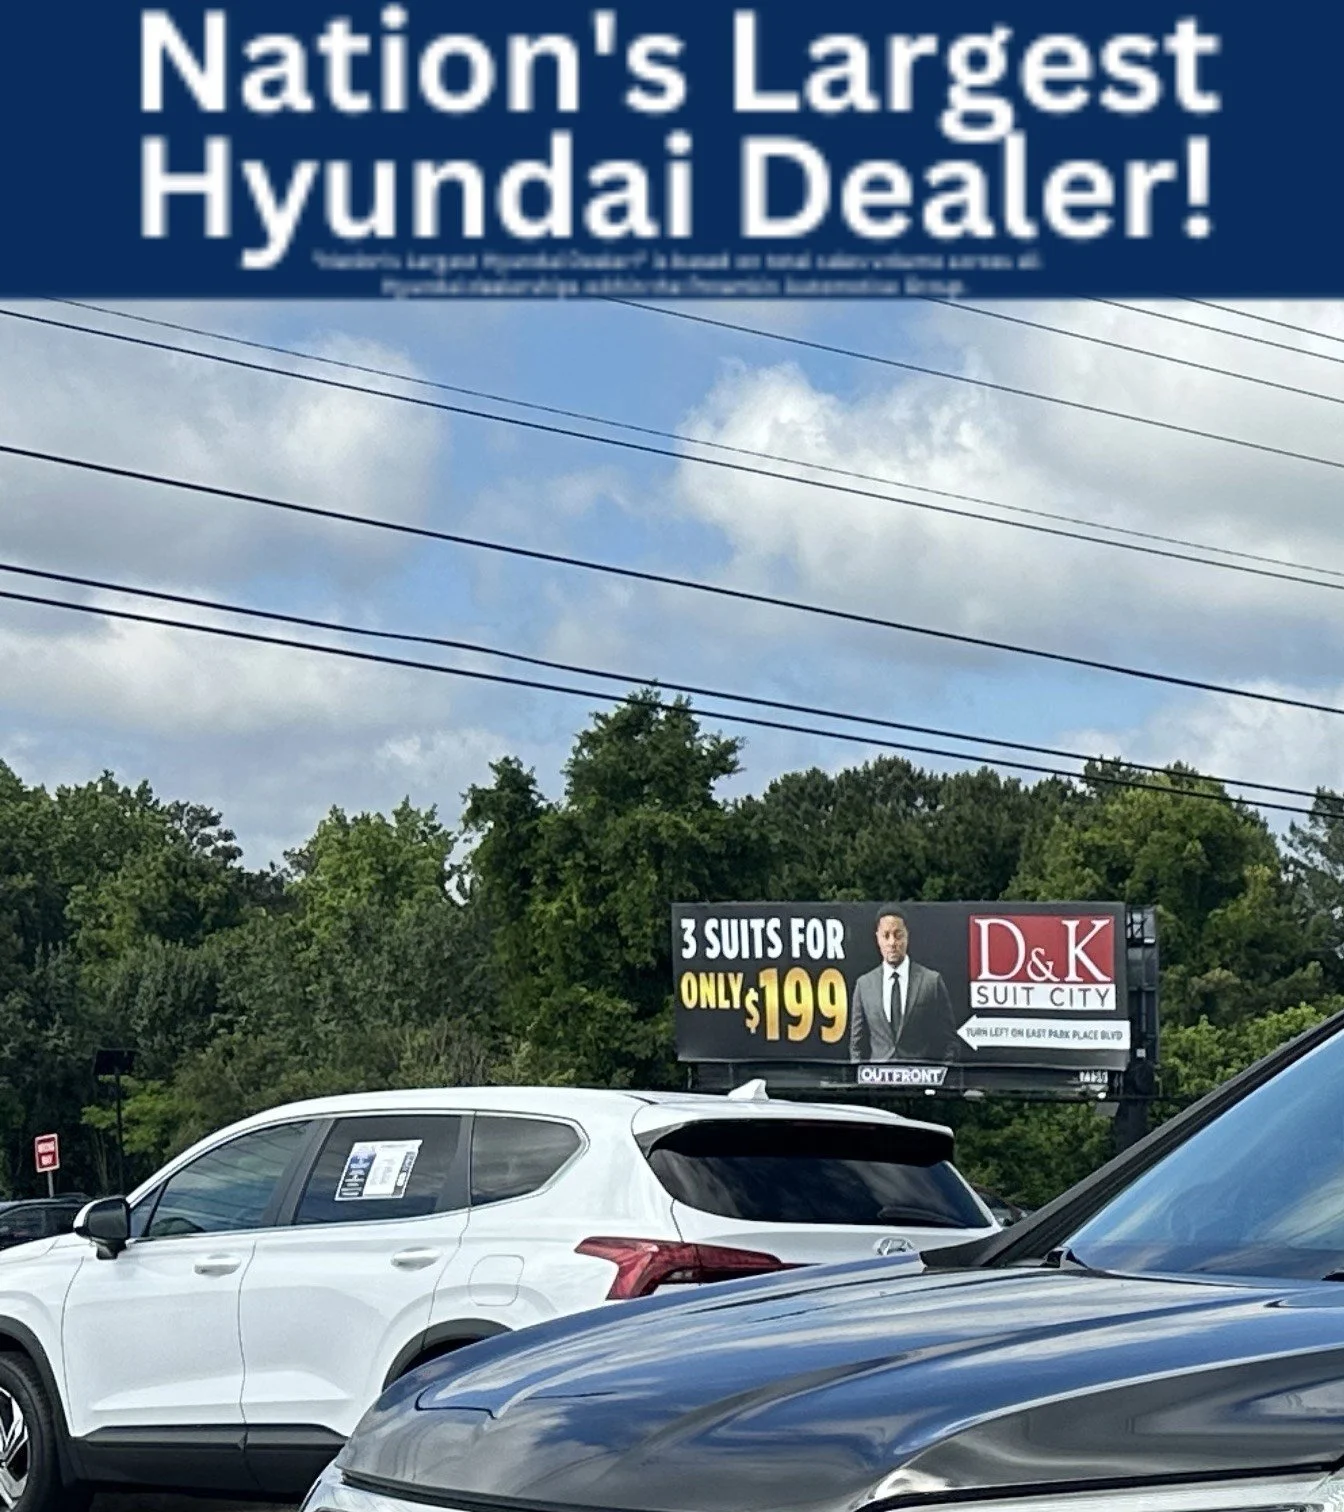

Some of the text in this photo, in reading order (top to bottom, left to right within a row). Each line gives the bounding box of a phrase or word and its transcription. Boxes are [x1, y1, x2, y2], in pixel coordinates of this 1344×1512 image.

[680, 917, 846, 960] 3 SUITS FOR
[974, 918, 1113, 983] D&K
[680, 967, 849, 1044] ONLY $199
[976, 985, 1111, 1008] SUIT CITY
[989, 1026, 1010, 1038] LEFT
[1011, 1027, 1025, 1038] ON
[1025, 1028, 1046, 1039] EAST
[1048, 1028, 1070, 1040] PARK
[1072, 1029, 1099, 1041] PLACE
[1100, 1030, 1124, 1041] BLVD
[860, 1066, 943, 1084] OUTFRONT
